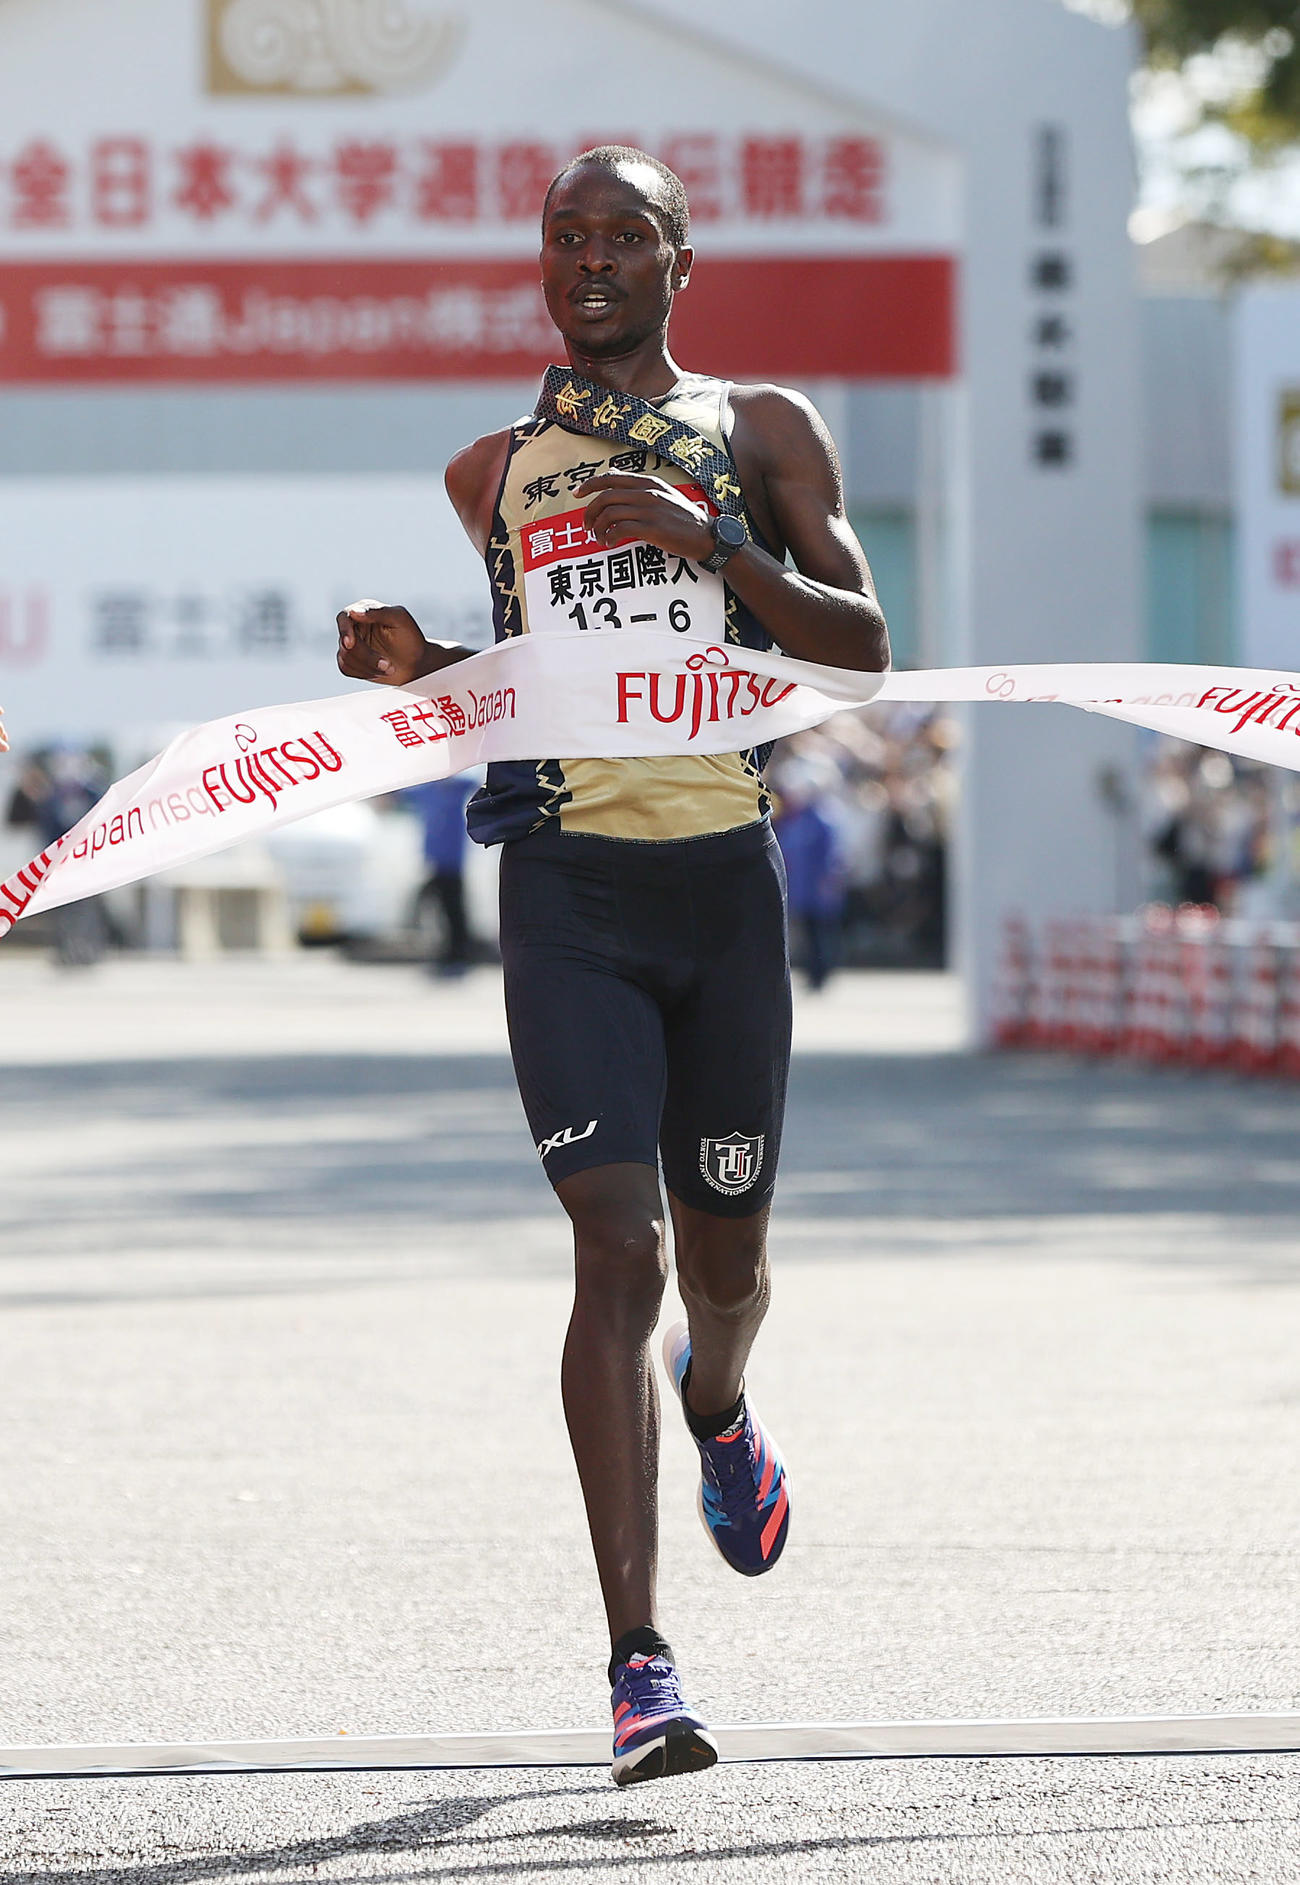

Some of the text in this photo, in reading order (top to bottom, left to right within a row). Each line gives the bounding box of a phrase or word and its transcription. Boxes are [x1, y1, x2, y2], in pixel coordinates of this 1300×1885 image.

[616, 671, 798, 741] FUJITSU
[1195, 687, 1300, 737] FUJIT
[202, 730, 342, 813] FUJITSU
[60, 807, 144, 865] apan
